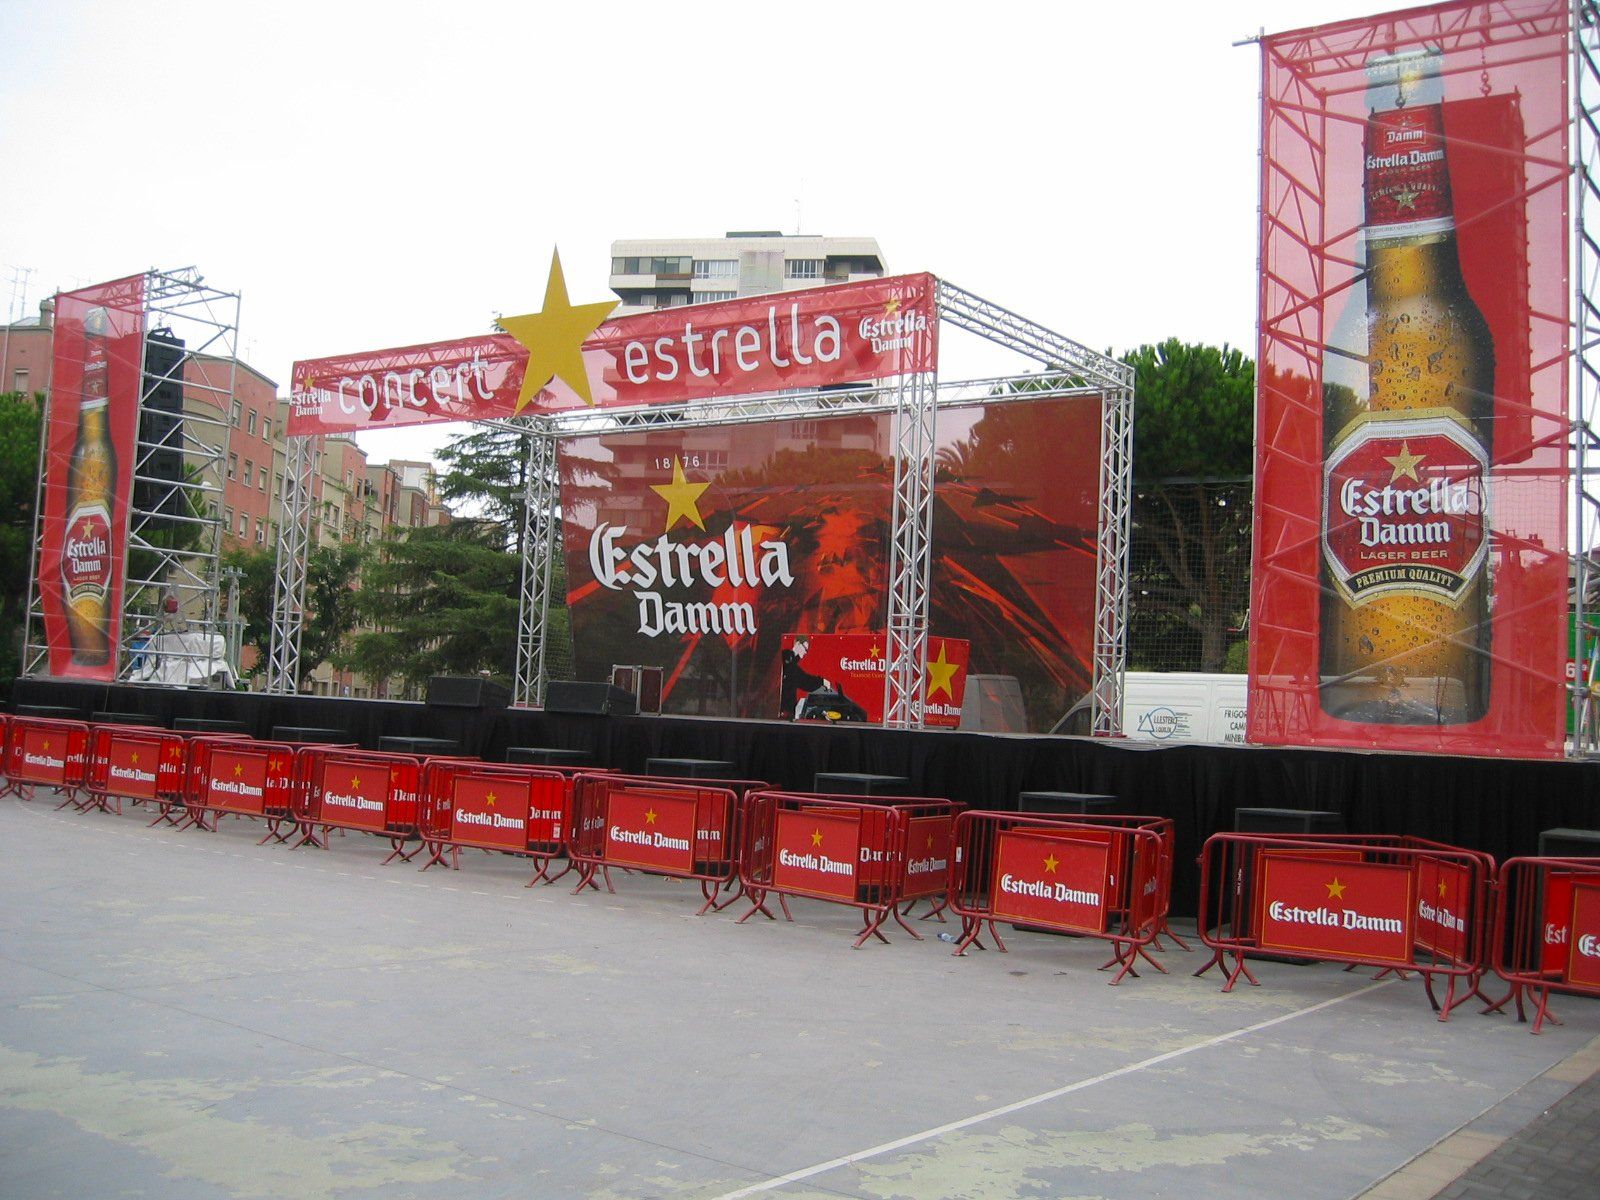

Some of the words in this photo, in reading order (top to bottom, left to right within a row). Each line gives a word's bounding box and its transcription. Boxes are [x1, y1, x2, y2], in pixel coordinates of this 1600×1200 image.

[1386, 130, 1424, 144] Damm
[1366, 153, 1409, 170] Estrella
[1409, 149, 1444, 165] Damm
[859, 309, 926, 340] Estrella
[871, 337, 913, 354] Damm
[338, 351, 495, 415] concert
[624, 303, 841, 385] estrella
[289, 383, 332, 406] Estrella
[295, 404, 323, 417] Damm
[1340, 477, 1470, 517] Estrella
[1358, 516, 1451, 547] Damm
[67, 536, 107, 558] Estrella
[588, 521, 795, 590] Estrella
[1360, 551, 1406, 560] LAGER
[1411, 549, 1448, 559] BEER
[71, 557, 101, 574] Damm
[1355, 567, 1406, 589] PREMIUM
[1408, 567, 1454, 587] QUALITY
[633, 590, 758, 638] Damm
[840, 656, 877, 671] Estrella
[211, 778, 239, 793] Estrella
[239, 781, 263, 798] Damm
[325, 791, 356, 808] Estrella
[356, 796, 384, 812] Damm
[456, 808, 492, 827] Estrella
[493, 813, 524, 830] Damm
[610, 825, 652, 846] Estrella
[653, 832, 690, 850] Damm
[779, 847, 818, 870] Estrella
[819, 856, 853, 876] Damm
[907, 856, 930, 875] Estrella
[1001, 872, 1052, 899] Estrella
[1053, 882, 1099, 907] Damm
[1269, 900, 1339, 928] Estrella
[1341, 908, 1403, 934] Damm
